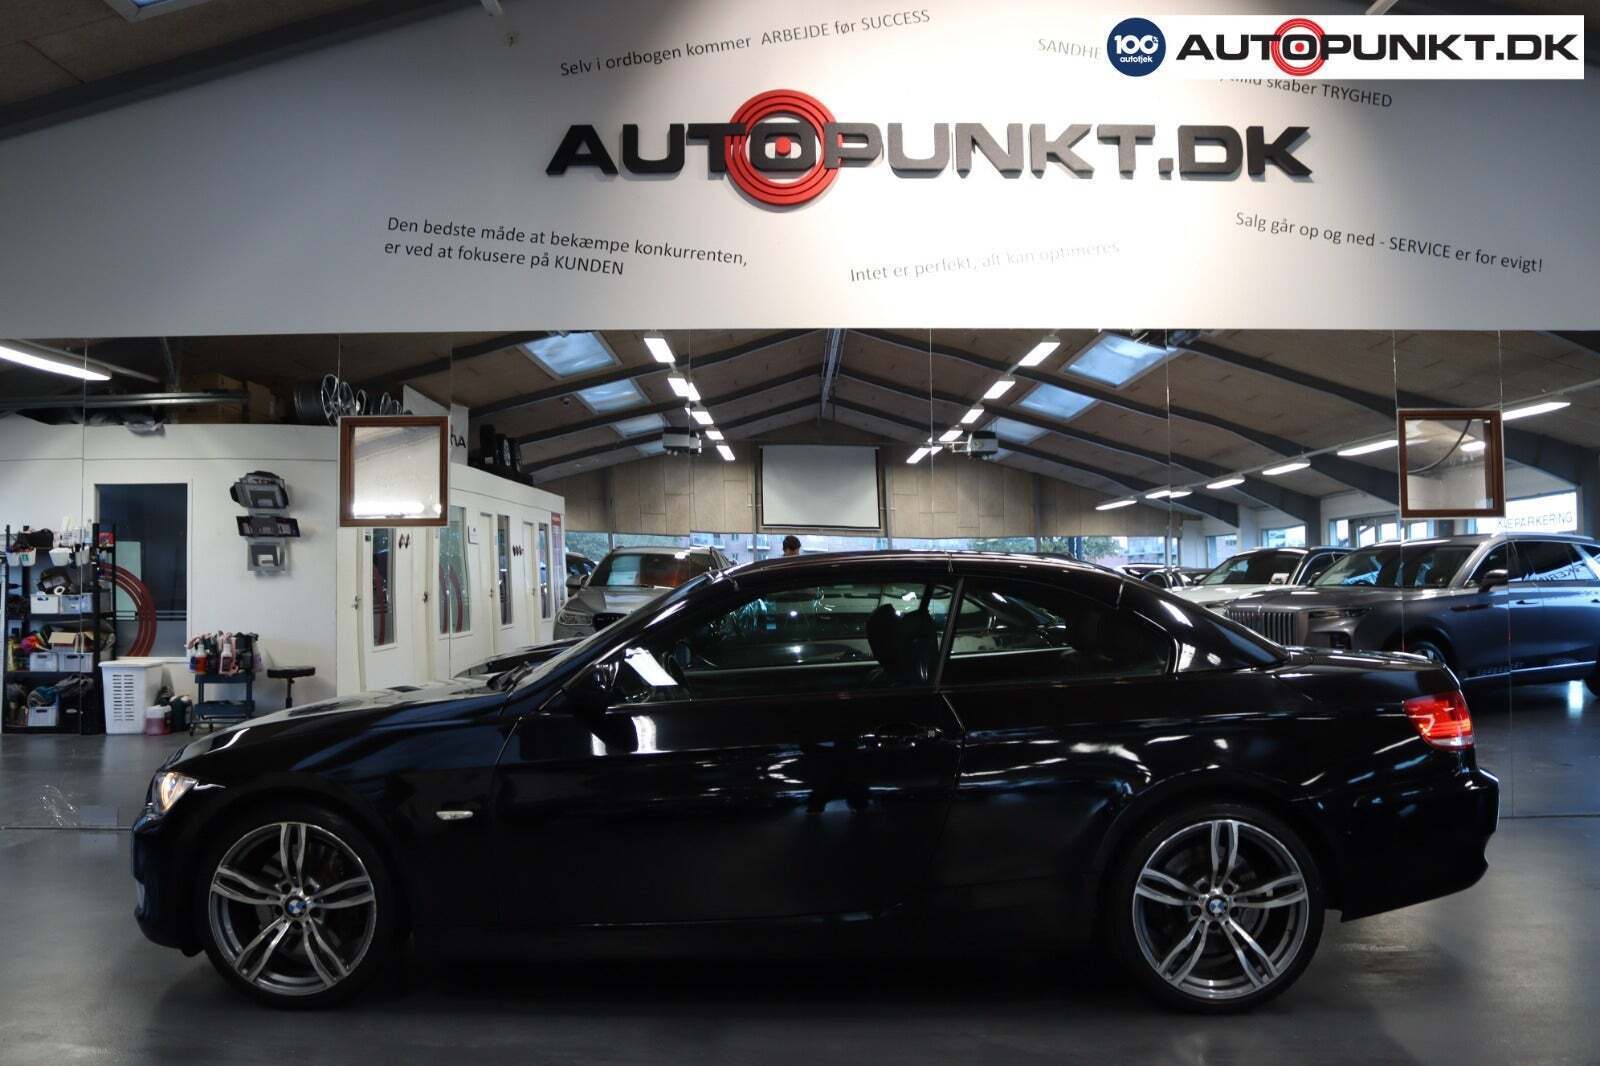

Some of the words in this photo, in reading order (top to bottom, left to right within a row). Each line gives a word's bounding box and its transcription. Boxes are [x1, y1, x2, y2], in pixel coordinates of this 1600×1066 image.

[560, 59, 592, 76] Selv
[596, 57, 601, 71] i
[606, 47, 682, 69] ordbogen
[686, 37, 752, 57] kommer
[761, 23, 830, 45] ARBEJDE
[835, 21, 857, 35] før
[861, 9, 931, 31] SUCCESS
[1267, 79, 1317, 95] skaber
[1322, 84, 1393, 107] TRYGHED
[546, 122, 1313, 181] AUTOPUNKT.DK
[384, 242, 401, 254] er
[405, 243, 434, 257] ved
[437, 246, 453, 259] at
[458, 245, 526, 265] fokusere
[530, 252, 549, 269] på
[554, 255, 624, 275] KUNDEN
[387, 216, 418, 232] Den
[423, 219, 476, 238] bedste
[480, 226, 526, 243] måde
[529, 231, 545, 245] at
[550, 231, 630, 253] bekæmpe
[634, 240, 748, 267] konkurrenten,
[1236, 212, 1266, 232] Salg
[1270, 217, 1295, 234] går
[1300, 225, 1319, 240] op
[1323, 229, 1342, 245] og
[1347, 233, 1375, 246] ned
[1389, 236, 1451, 259] SERVICE
[1455, 249, 1471, 261] er
[1475, 249, 1497, 265] for
[1501, 256, 1543, 273] evigt!
[850, 266, 889, 283] Intet
[893, 265, 908, 278] er
[914, 257, 976, 278] perfekt,
